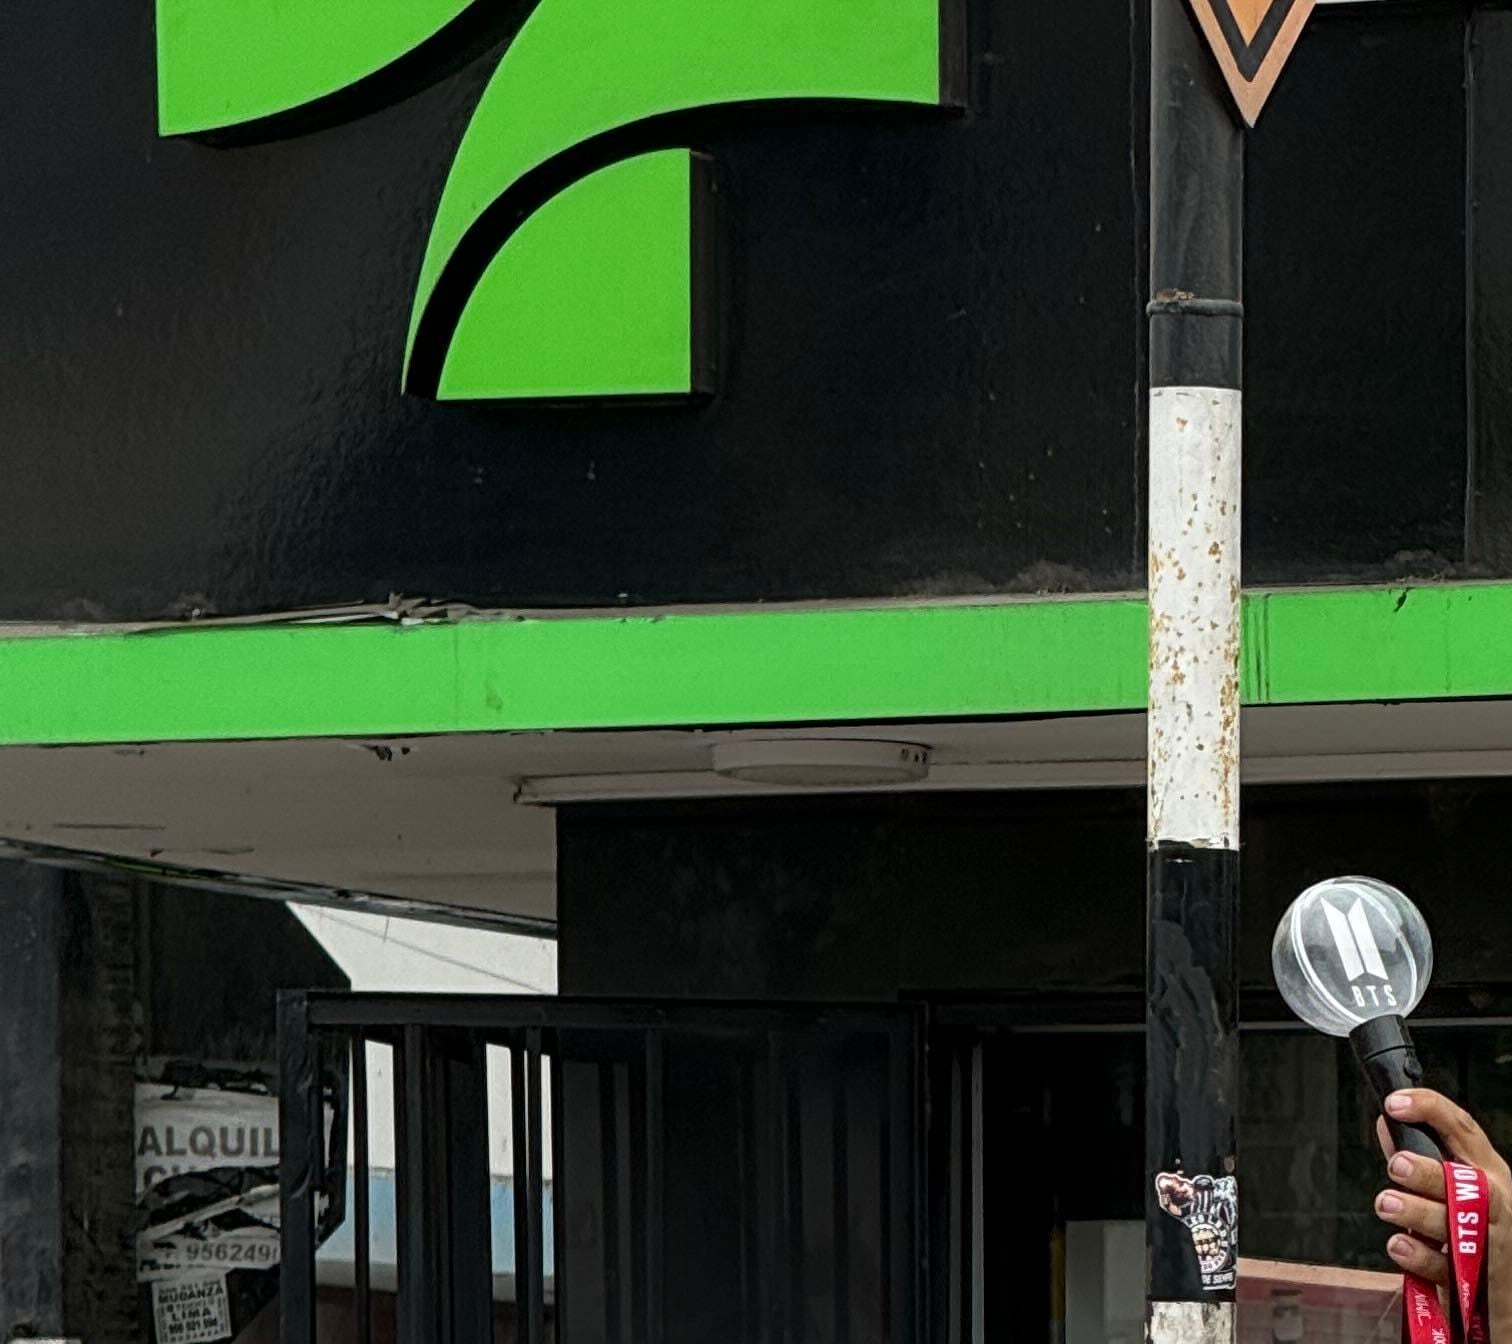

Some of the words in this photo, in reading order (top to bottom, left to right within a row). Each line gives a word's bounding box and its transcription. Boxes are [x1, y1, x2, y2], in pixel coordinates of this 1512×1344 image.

[1351, 984, 1397, 1008] BTS
[1453, 1163, 1480, 1202] WO
[1458, 1211, 1480, 1254] BTS
